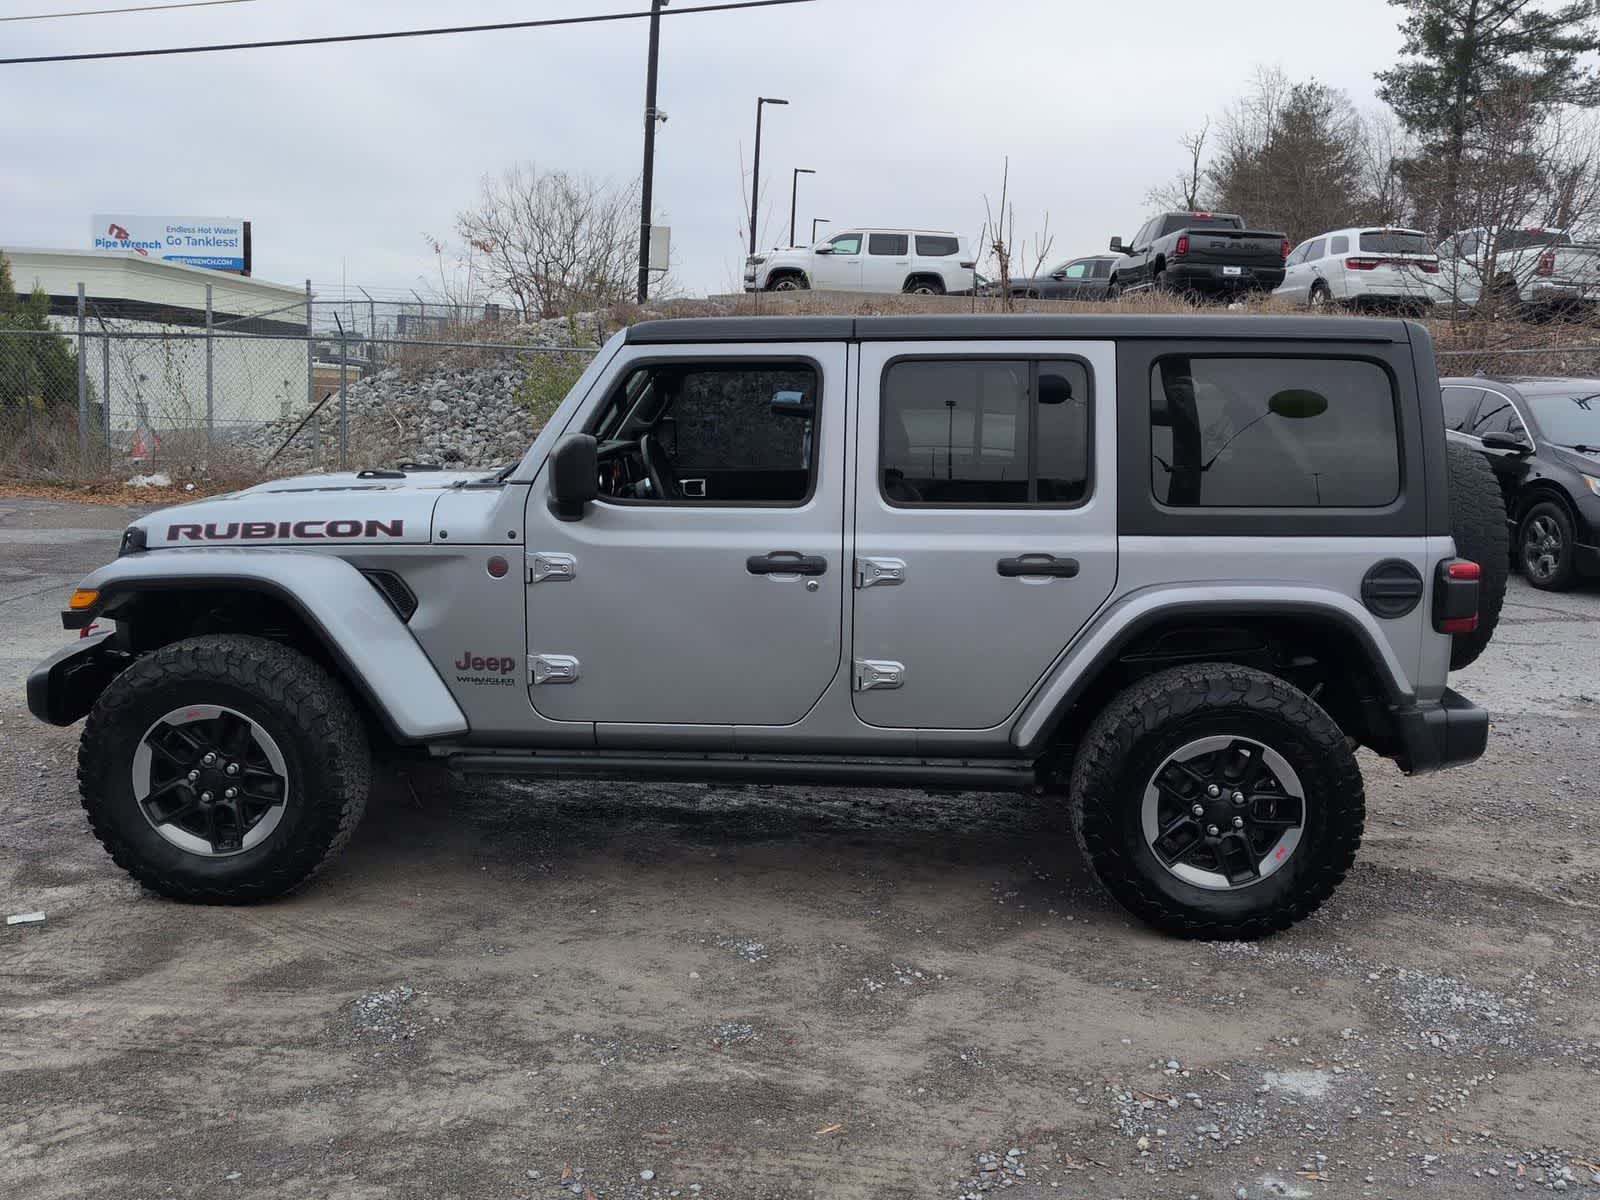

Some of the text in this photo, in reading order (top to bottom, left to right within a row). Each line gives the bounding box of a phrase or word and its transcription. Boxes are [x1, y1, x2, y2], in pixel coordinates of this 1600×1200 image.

[166, 225, 238, 235] Endless Hot Water
[95, 238, 161, 249] Pipe Wrench
[166, 235, 238, 248] Go Tankless!
[1210, 240, 1260, 250] RAM
[166, 519, 404, 541] RUBICON
[455, 651, 515, 675] Jeep
